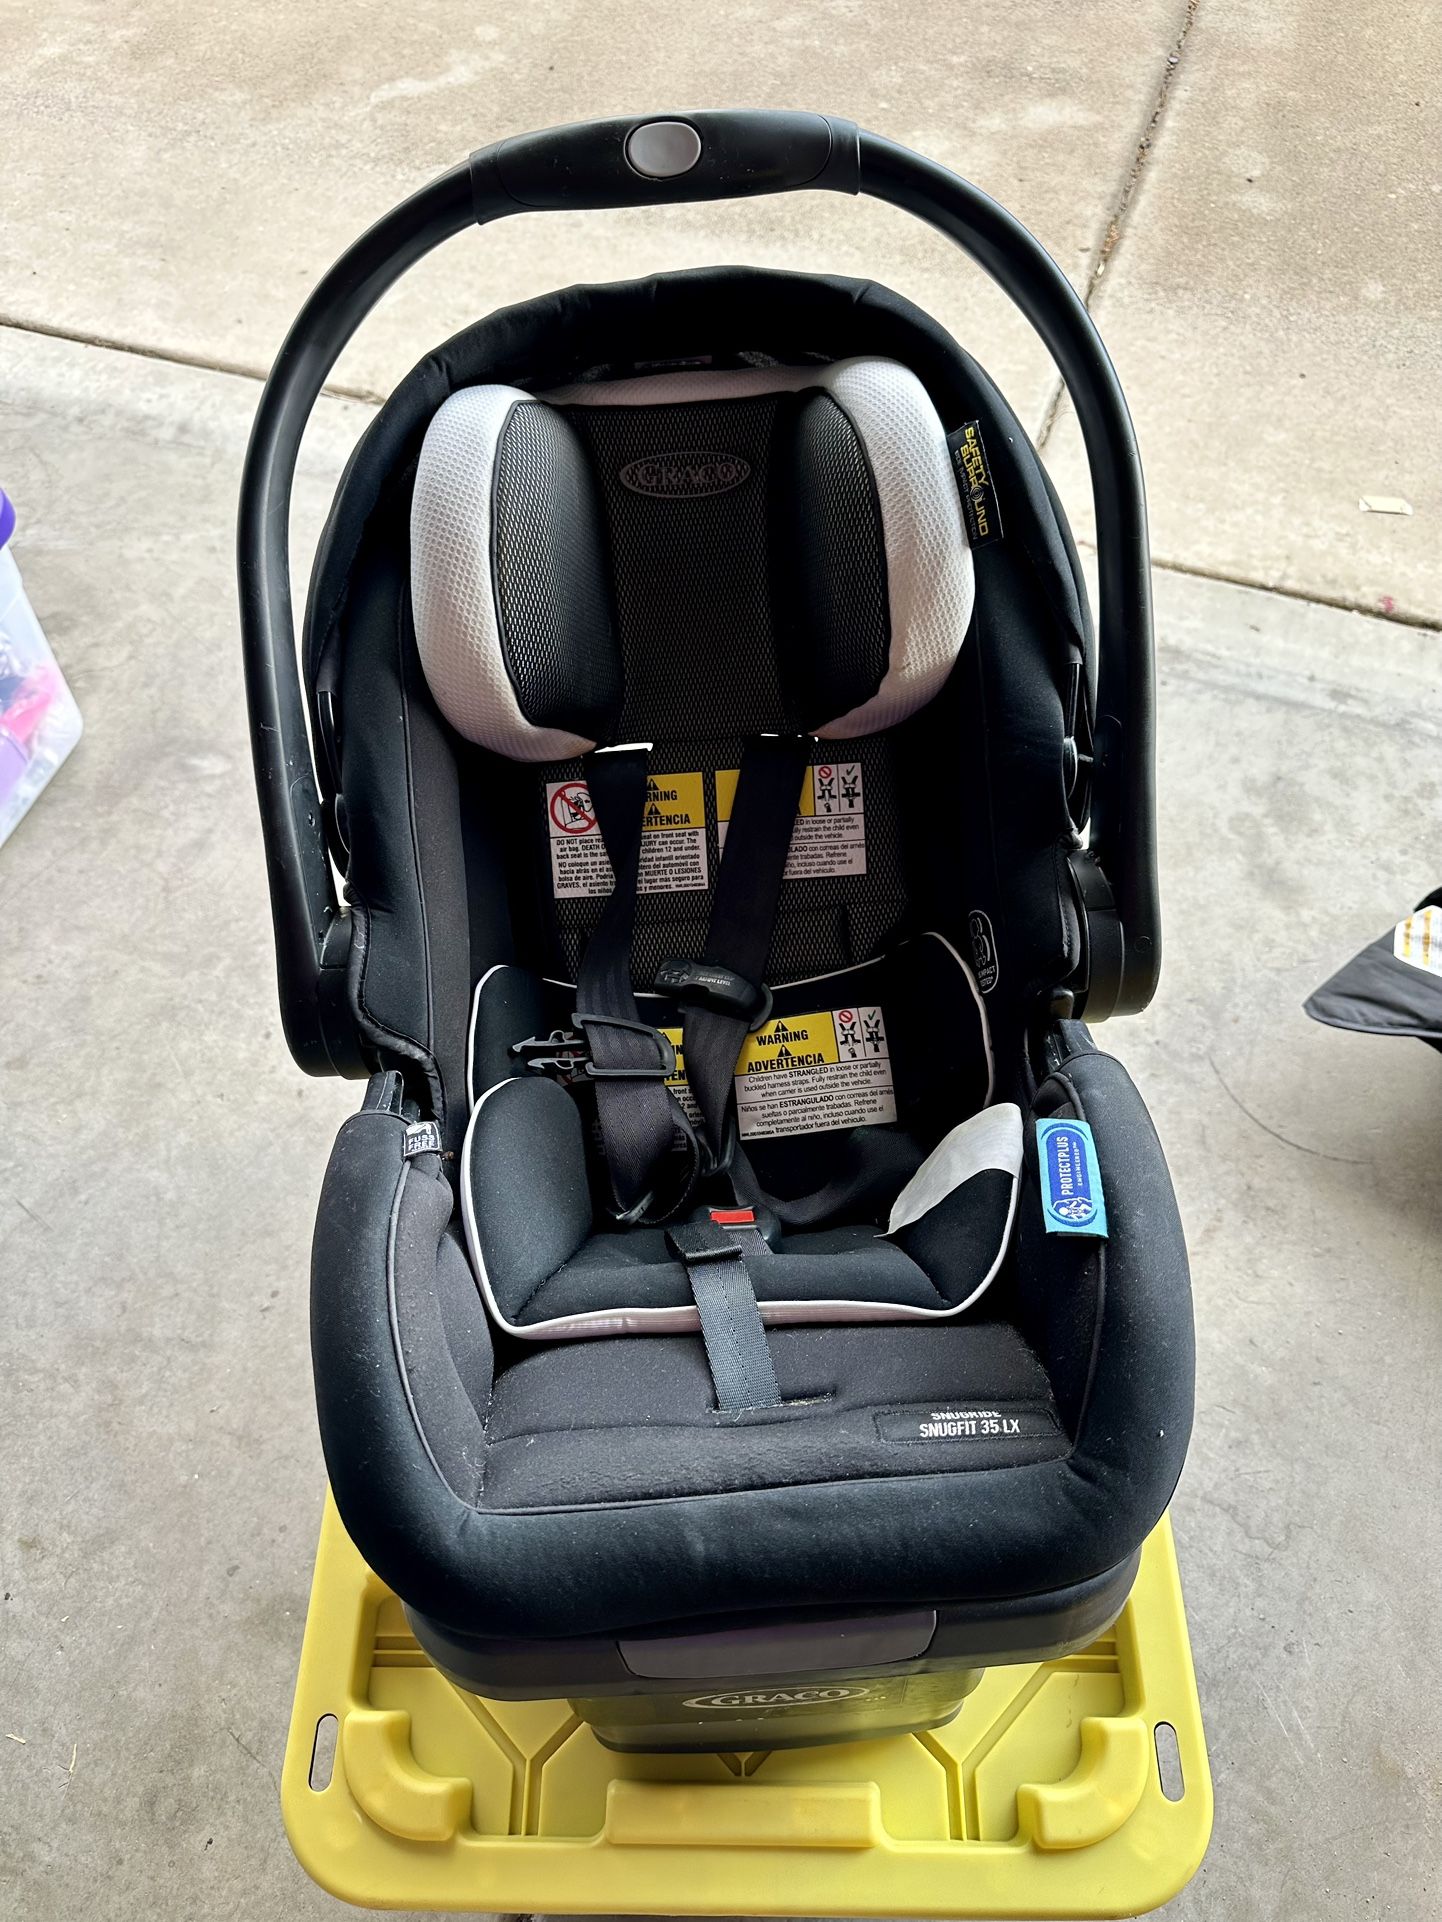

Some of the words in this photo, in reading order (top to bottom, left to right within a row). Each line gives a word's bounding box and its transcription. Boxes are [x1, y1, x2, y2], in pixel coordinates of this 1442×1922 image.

[965, 427, 989, 486] SAFETY
[637, 462, 736, 486] GRACO
[961, 444, 989, 536] SURROUND
[647, 790, 677, 802] RNING
[641, 814, 690, 826] ERTENCIA
[757, 1030, 809, 1046] WARNING
[748, 1053, 824, 1072] ADVERTENCIA
[789, 1067, 828, 1078] STRANGLED
[860, 1061, 881, 1069] partially
[812, 1076, 826, 1085] Fully
[780, 1095, 834, 1108] ESTRANGULADO
[757, 1116, 800, 1127] completamente
[845, 1108, 866, 1116] cuando
[788, 1106, 825, 1116] parcialmente
[776, 1124, 814, 1133] transportador
[815, 1119, 830, 1128] fuera
[1057, 1136, 1074, 1196] PROTECTPLUS
[919, 1420, 976, 1438] SNUGFIT
[981, 1419, 1000, 1434] 35
[1003, 1419, 1020, 1433] LX
[711, 1689, 850, 1706] GRACO
